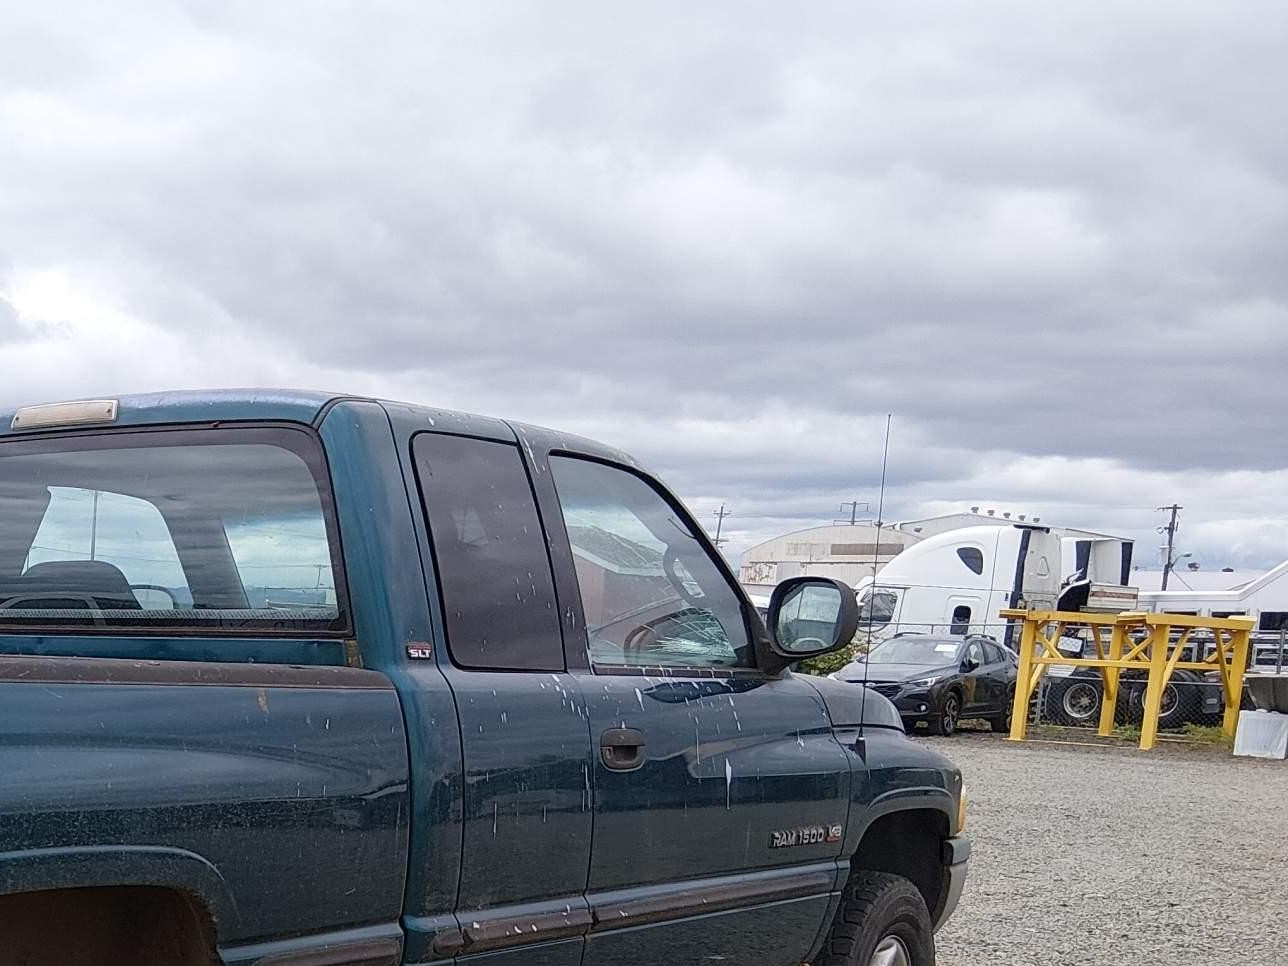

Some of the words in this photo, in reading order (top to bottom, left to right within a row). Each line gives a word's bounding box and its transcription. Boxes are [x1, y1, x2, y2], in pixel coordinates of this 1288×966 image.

[408, 649, 432, 658] SLT
[772, 830, 797, 847] RAM
[798, 827, 825, 845] 1500
